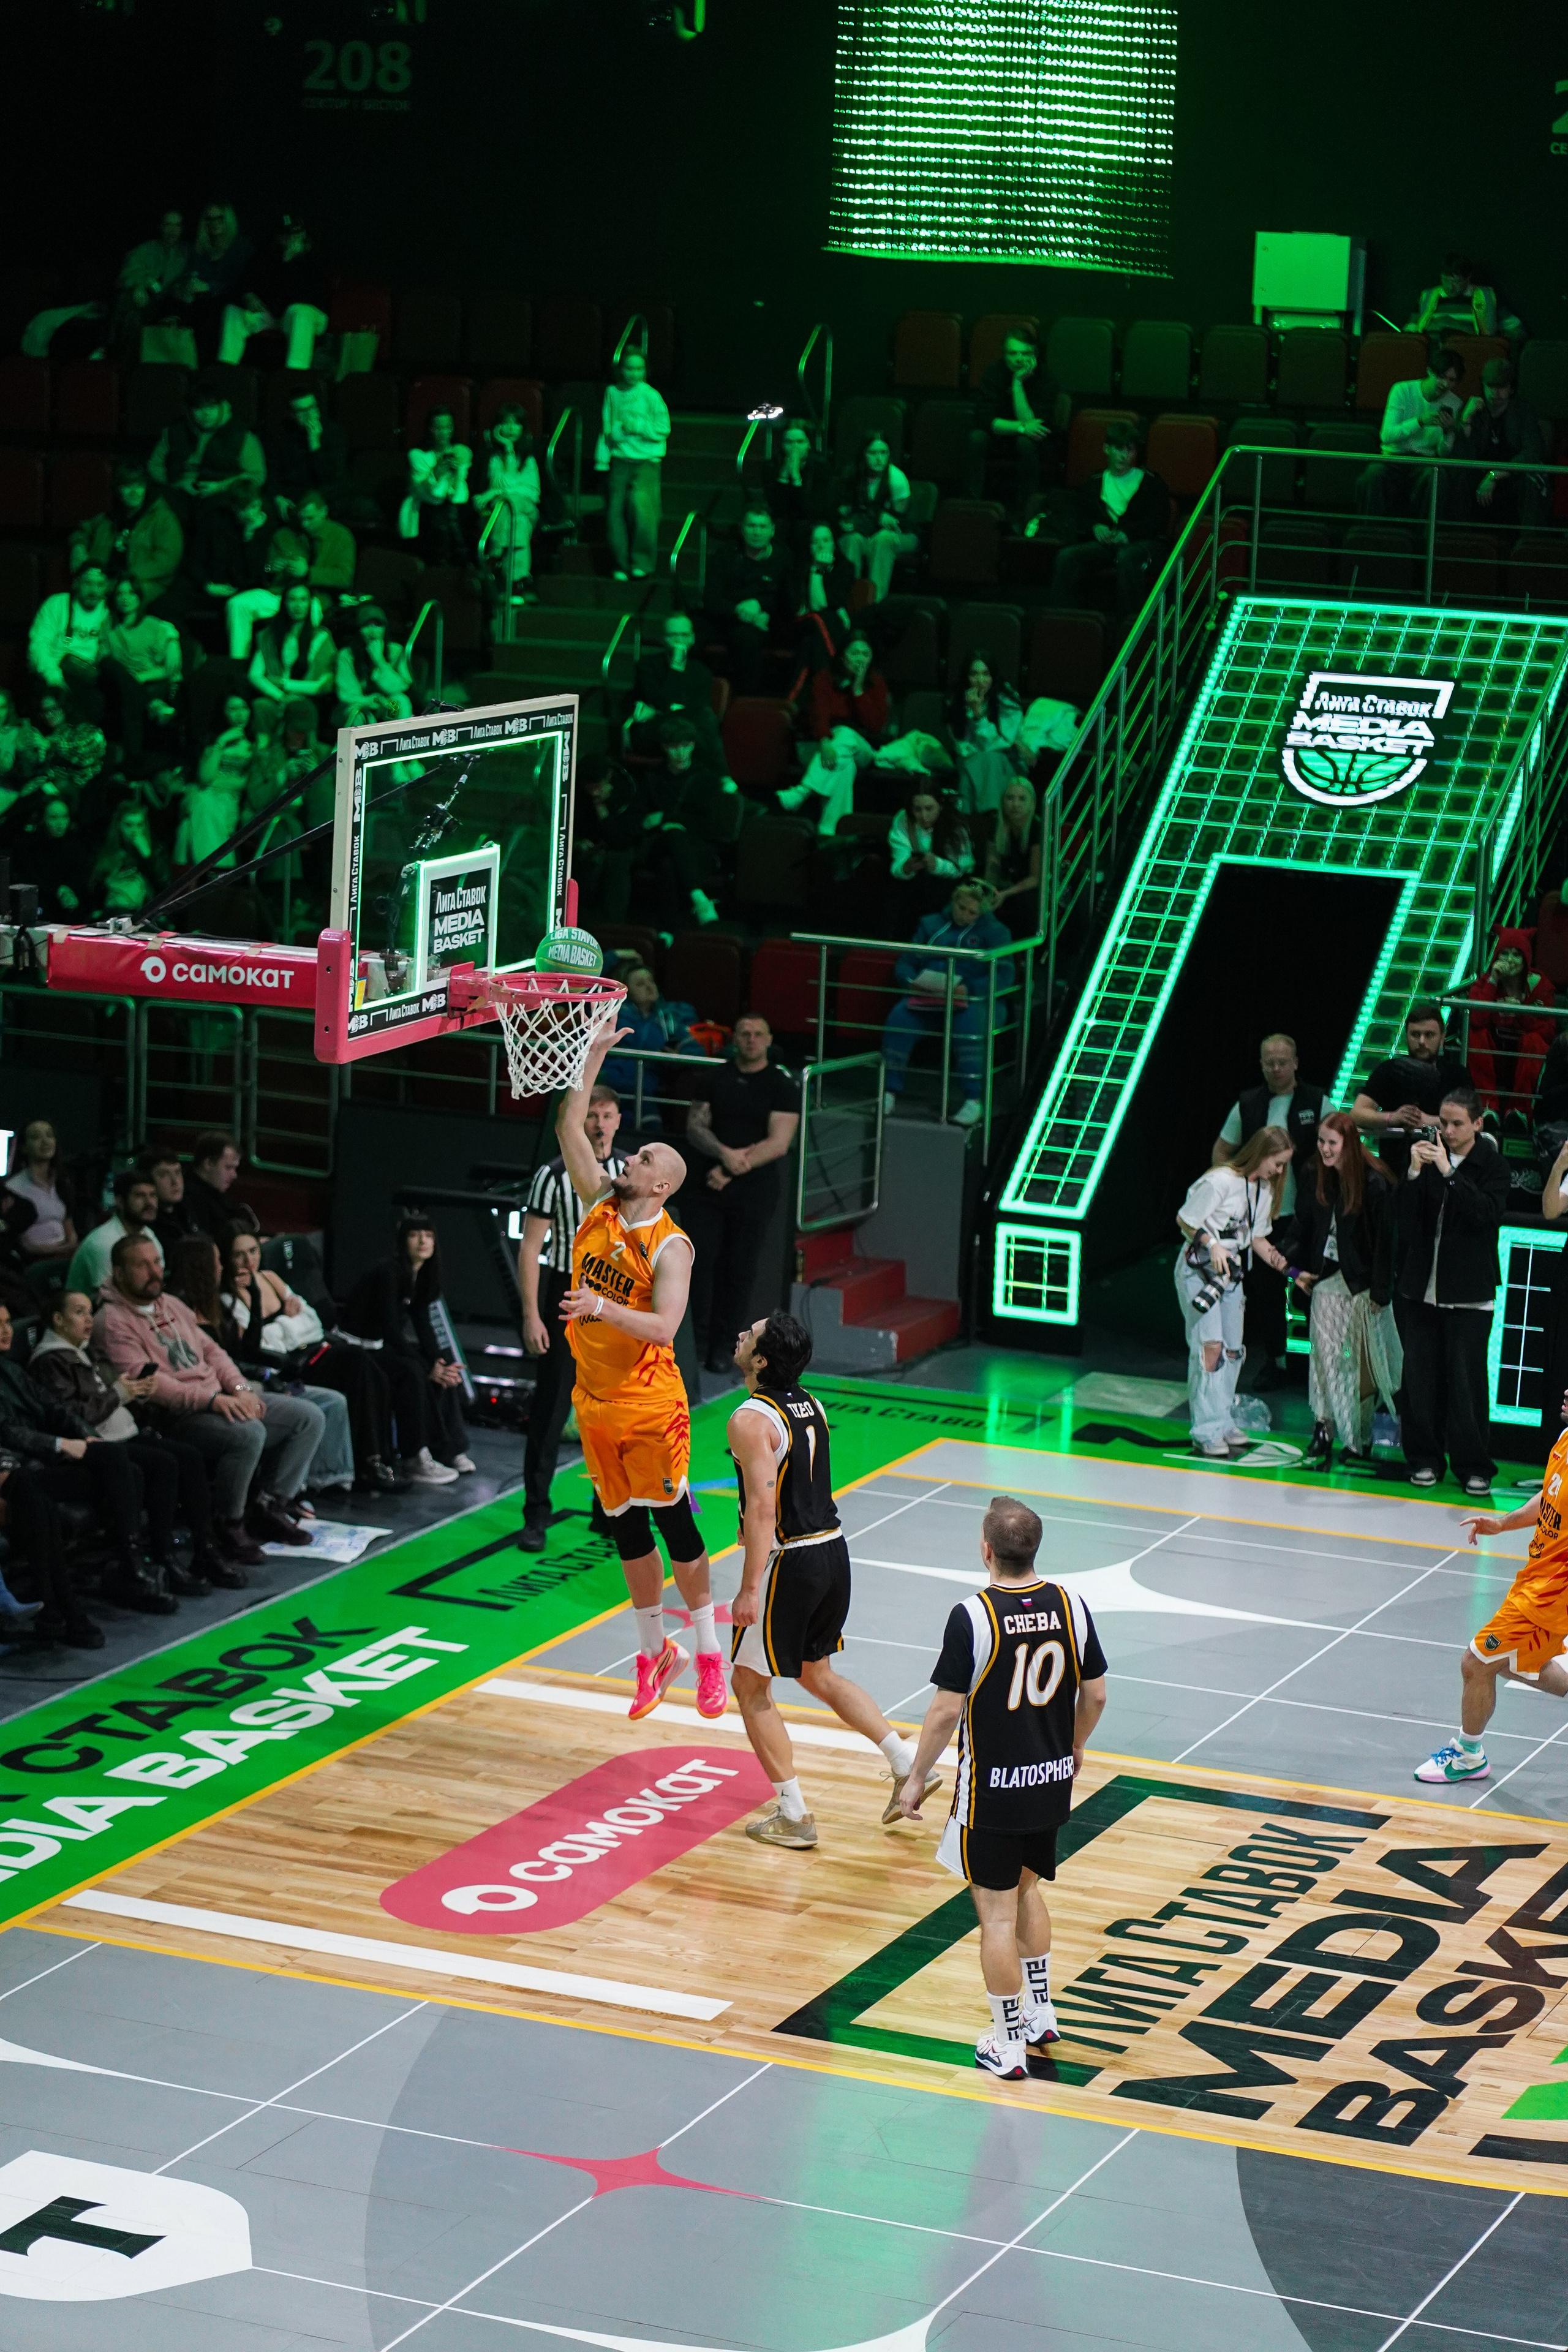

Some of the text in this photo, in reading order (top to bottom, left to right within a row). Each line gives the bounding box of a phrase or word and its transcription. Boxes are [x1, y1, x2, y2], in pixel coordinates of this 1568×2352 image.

[303, 39, 412, 92] 208
[1290, 710, 1435, 740] MEDIA
[1285, 730, 1434, 755] BASKET
[434, 909, 484, 937] MEDIA
[551, 929, 568, 940] LIGA
[434, 929, 484, 954] BASKET
[548, 944, 597, 967] MEDIA BASKET
[172, 963, 295, 989] самокат
[582, 1251, 635, 1297] MASTER
[601, 1287, 629, 1306] COLOR
[805, 1425, 816, 1482] 1
[1003, 1610, 1061, 1635] CHEBA
[1008, 1640, 1065, 1711] 10
[1, 1617, 380, 1774] СТАВОК
[104, 1626, 470, 1789] BASKET
[989, 1755, 1074, 1789] BLATOSPHER
[509, 1758, 739, 1882] самокат
[1109, 1843, 1551, 2120] MEDIA
